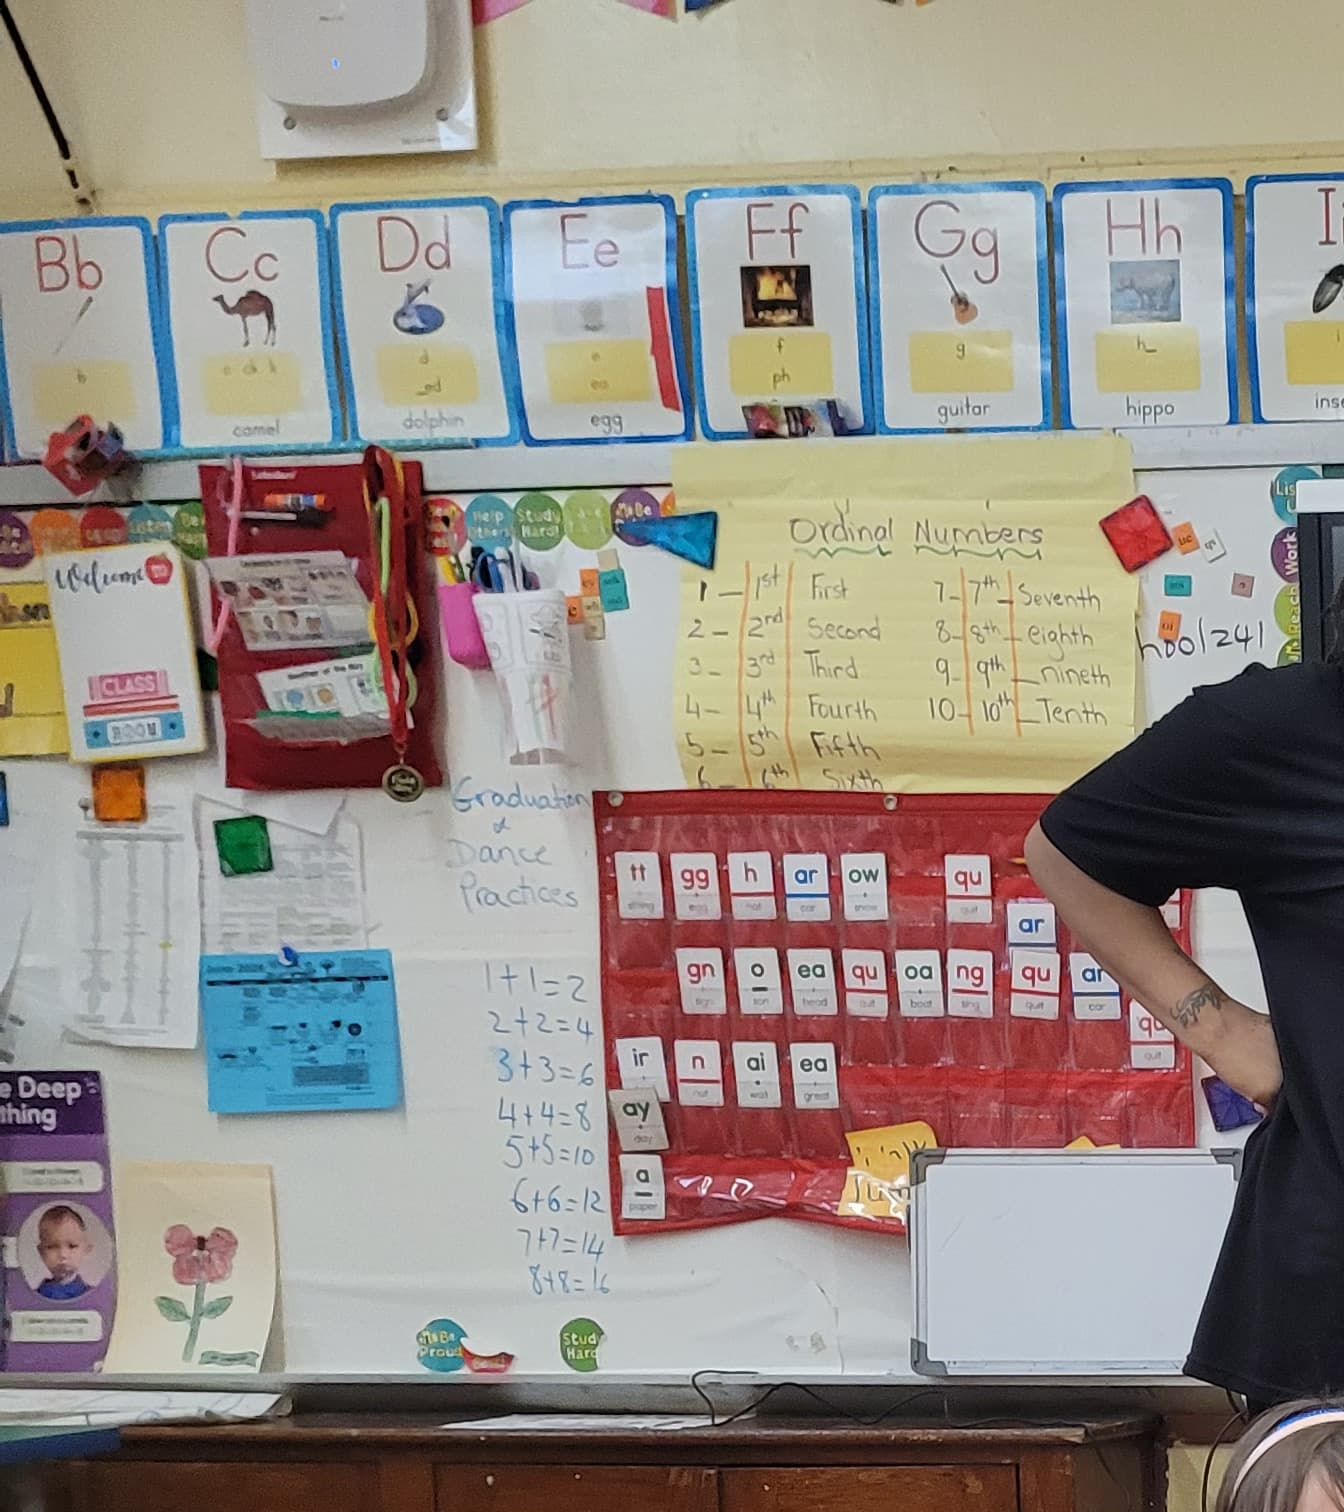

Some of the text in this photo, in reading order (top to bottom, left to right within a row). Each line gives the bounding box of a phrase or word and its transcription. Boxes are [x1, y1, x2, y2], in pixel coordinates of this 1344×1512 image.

[747, 202, 809, 260] Ff
[1107, 198, 1182, 255] Hh
[376, 216, 451, 272] Dd
[560, 215, 619, 269] Ee
[914, 201, 999, 284] Gg
[35, 236, 102, 293] Bb
[205, 227, 279, 282] Cc
[403, 411, 464, 432] dolphin
[938, 401, 989, 423] guitar
[1127, 399, 1174, 423] hippo
[233, 420, 280, 439] camel
[590, 414, 623, 434] egg
[516, 509, 561, 523] Study
[790, 518, 1043, 546] Ordinal Numbers
[811, 573, 848, 601] First
[1018, 583, 1101, 610] Seventh
[807, 616, 881, 641] Second
[1028, 622, 1095, 662] eighth
[803, 650, 859, 679] Third
[1041, 661, 1111, 688] nineth
[103, 675, 156, 695] CLASS
[809, 695, 876, 721] Fourth
[1035, 697, 1108, 726] Tenth
[813, 731, 881, 760] Fifth
[451, 776, 593, 814] Graduation
[447, 839, 551, 868] Dance
[630, 864, 646, 881] tt
[681, 867, 710, 890] gg
[744, 863, 757, 881] h
[794, 868, 819, 885] ar
[848, 868, 880, 884] ow
[954, 870, 982, 892] qu
[460, 875, 579, 913] Practices
[1019, 916, 1045, 934] ar
[687, 962, 715, 983] gn
[751, 963, 765, 978] o
[797, 962, 826, 979] ea
[852, 963, 878, 986] qu
[904, 964, 933, 981] oa
[956, 963, 984, 985] ng
[1021, 964, 1050, 987] qu
[632, 1048, 649, 1066] ir
[692, 1053, 704, 1069] n
[747, 1053, 766, 1071] ai
[800, 1056, 827, 1073] ea
[17, 1076, 82, 1105] Deep
[623, 1100, 650, 1122] ay
[636, 1168, 650, 1184] a
